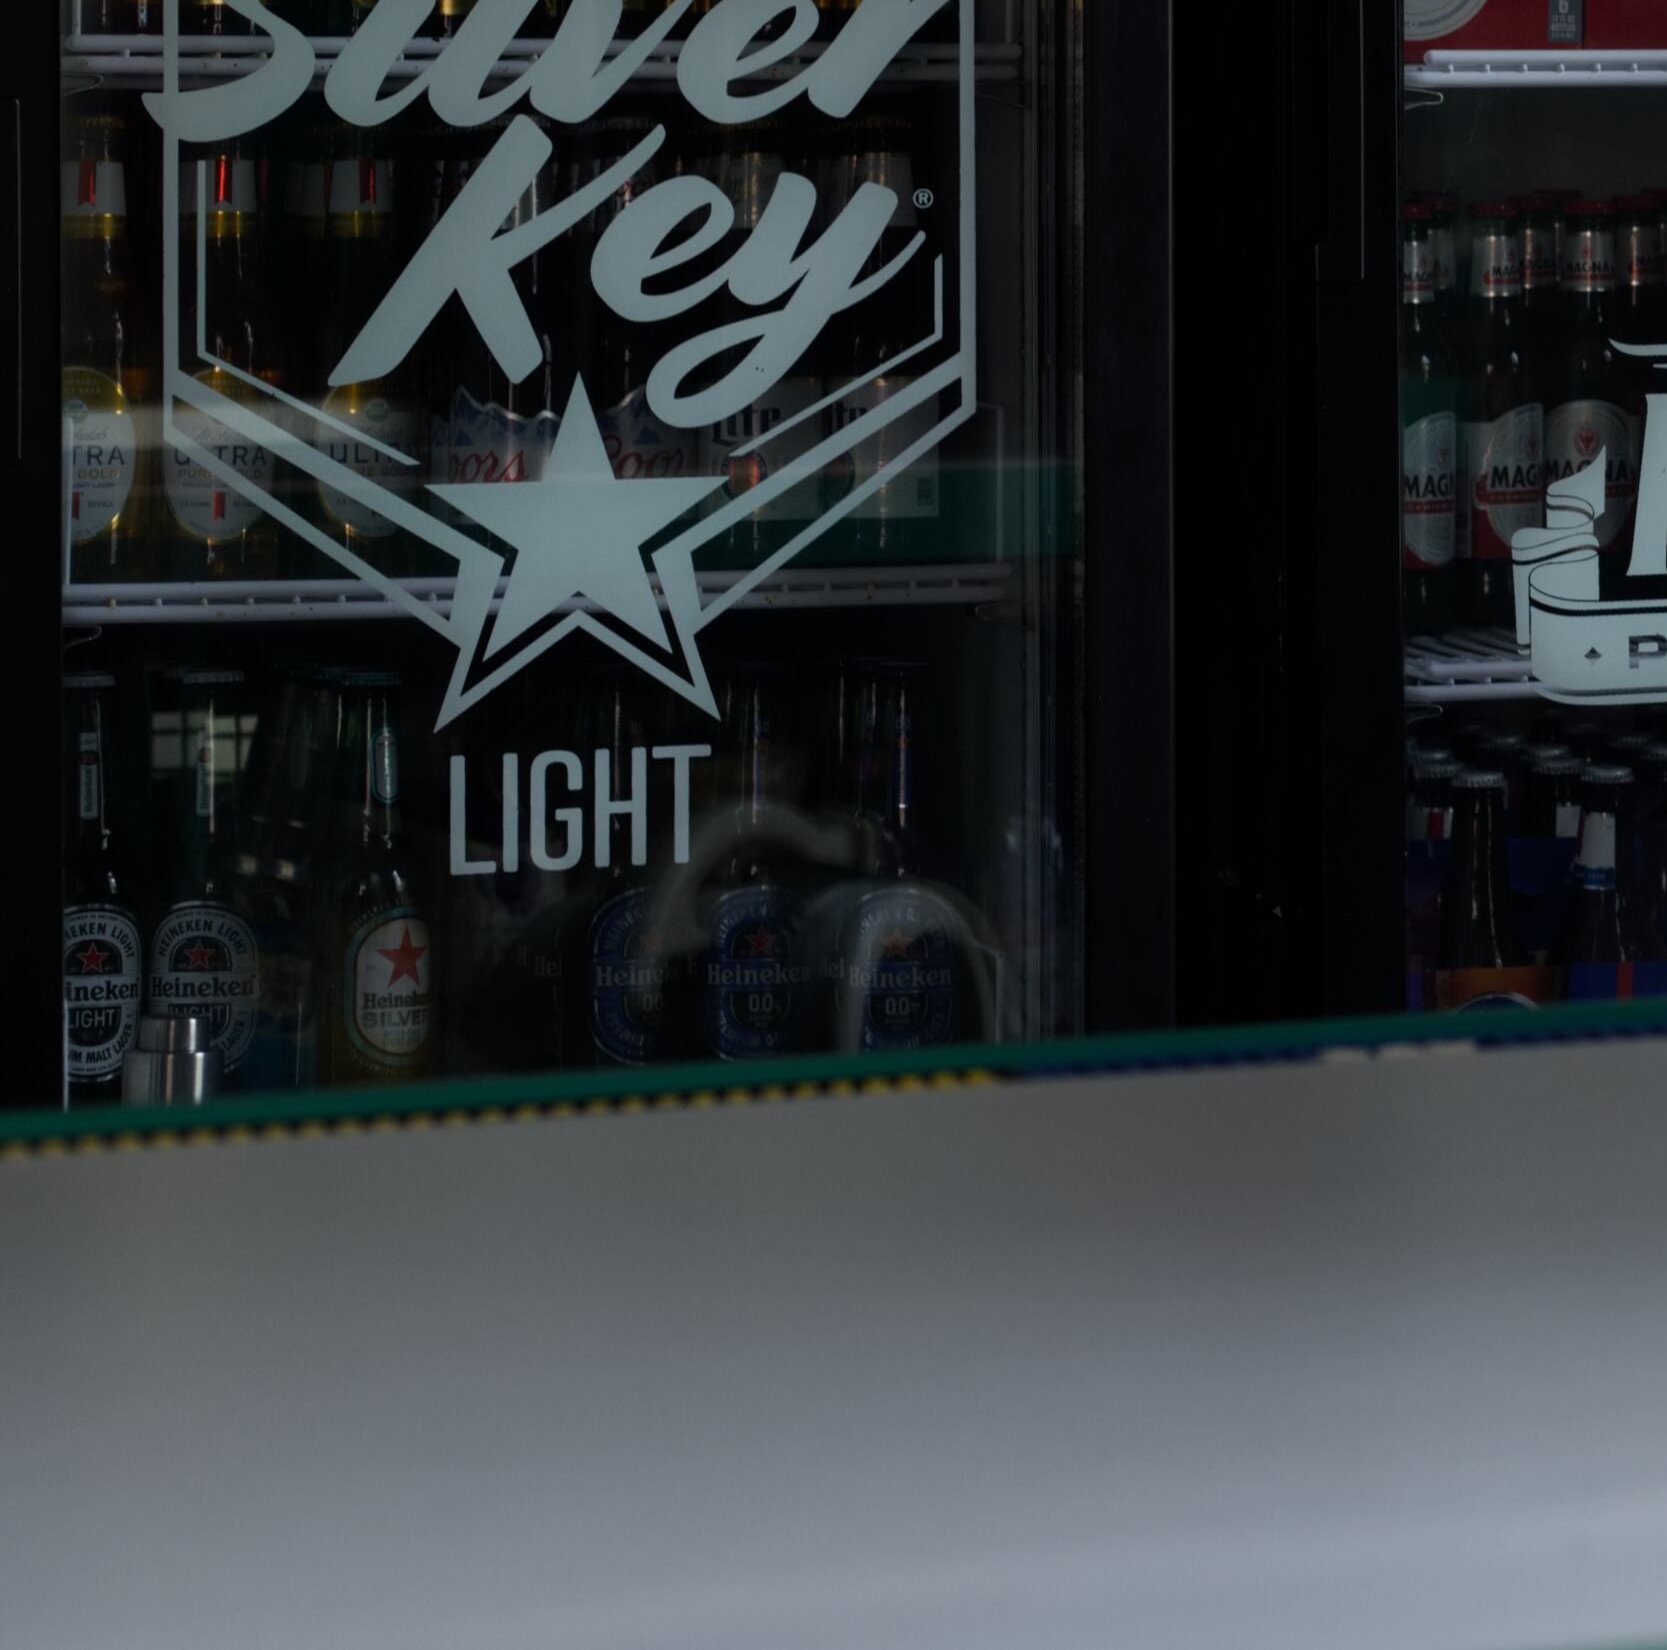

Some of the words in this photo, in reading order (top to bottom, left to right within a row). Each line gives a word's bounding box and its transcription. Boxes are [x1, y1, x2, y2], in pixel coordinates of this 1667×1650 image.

[327, 113, 927, 428] Key
[174, 444, 268, 467] UTRA
[449, 743, 713, 877] LIGHT
[151, 976, 254, 998] Heineken
